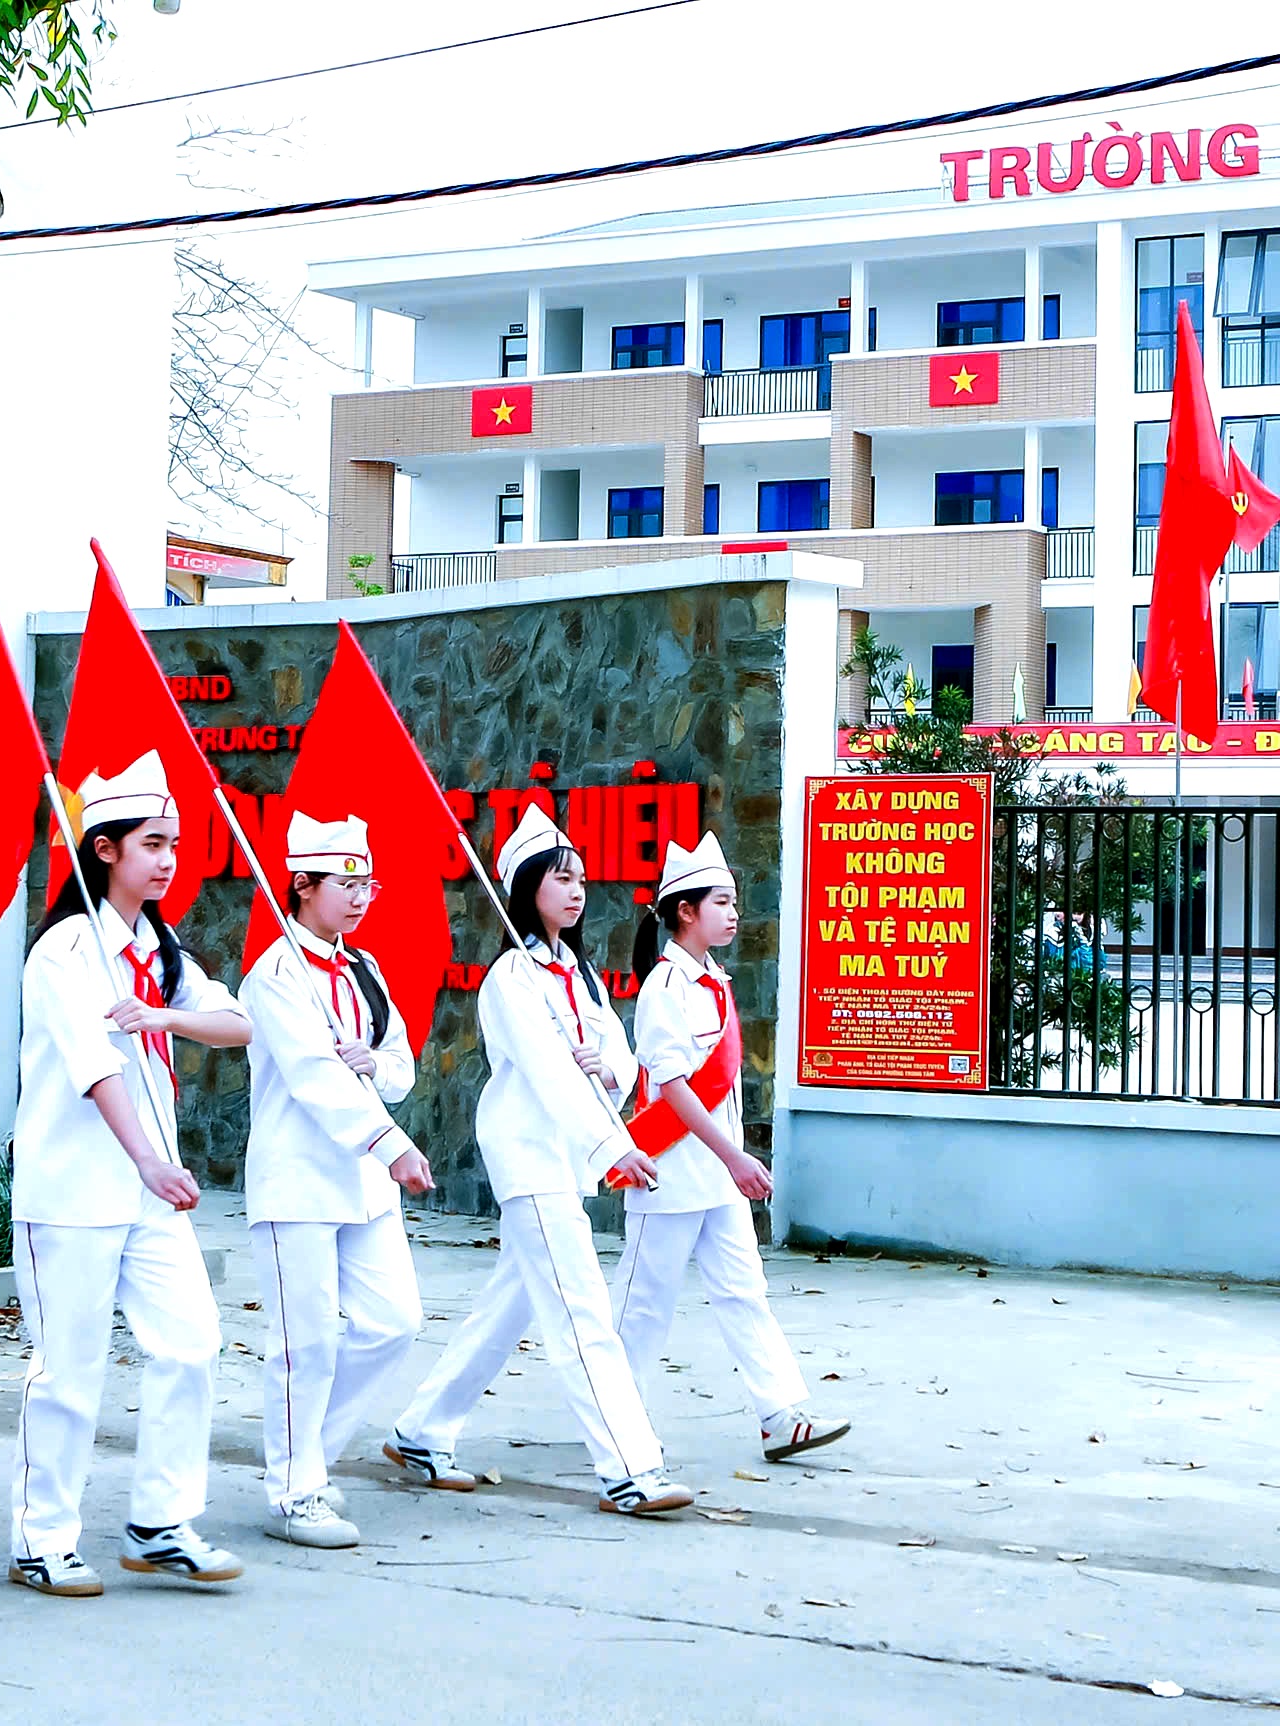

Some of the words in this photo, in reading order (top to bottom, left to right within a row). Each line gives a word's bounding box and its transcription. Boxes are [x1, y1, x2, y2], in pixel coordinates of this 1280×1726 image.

[940, 121, 1260, 202] TRƯỜNG
[168, 675, 232, 700] BND
[835, 788, 883, 811] XÂY
[891, 790, 959, 814] DỰNG
[819, 819, 917, 841] TRƯỜNG
[925, 823, 975, 844] HỌC
[846, 848, 945, 874] KHÔNG
[825, 882, 869, 912] TỘI
[879, 887, 965, 913] PHẠM
[819, 917, 856, 943] VÀ
[864, 917, 897, 946] TỆ
[907, 922, 970, 948] NẠN
[839, 955, 886, 977] MA
[895, 952, 949, 978] TUÝ
